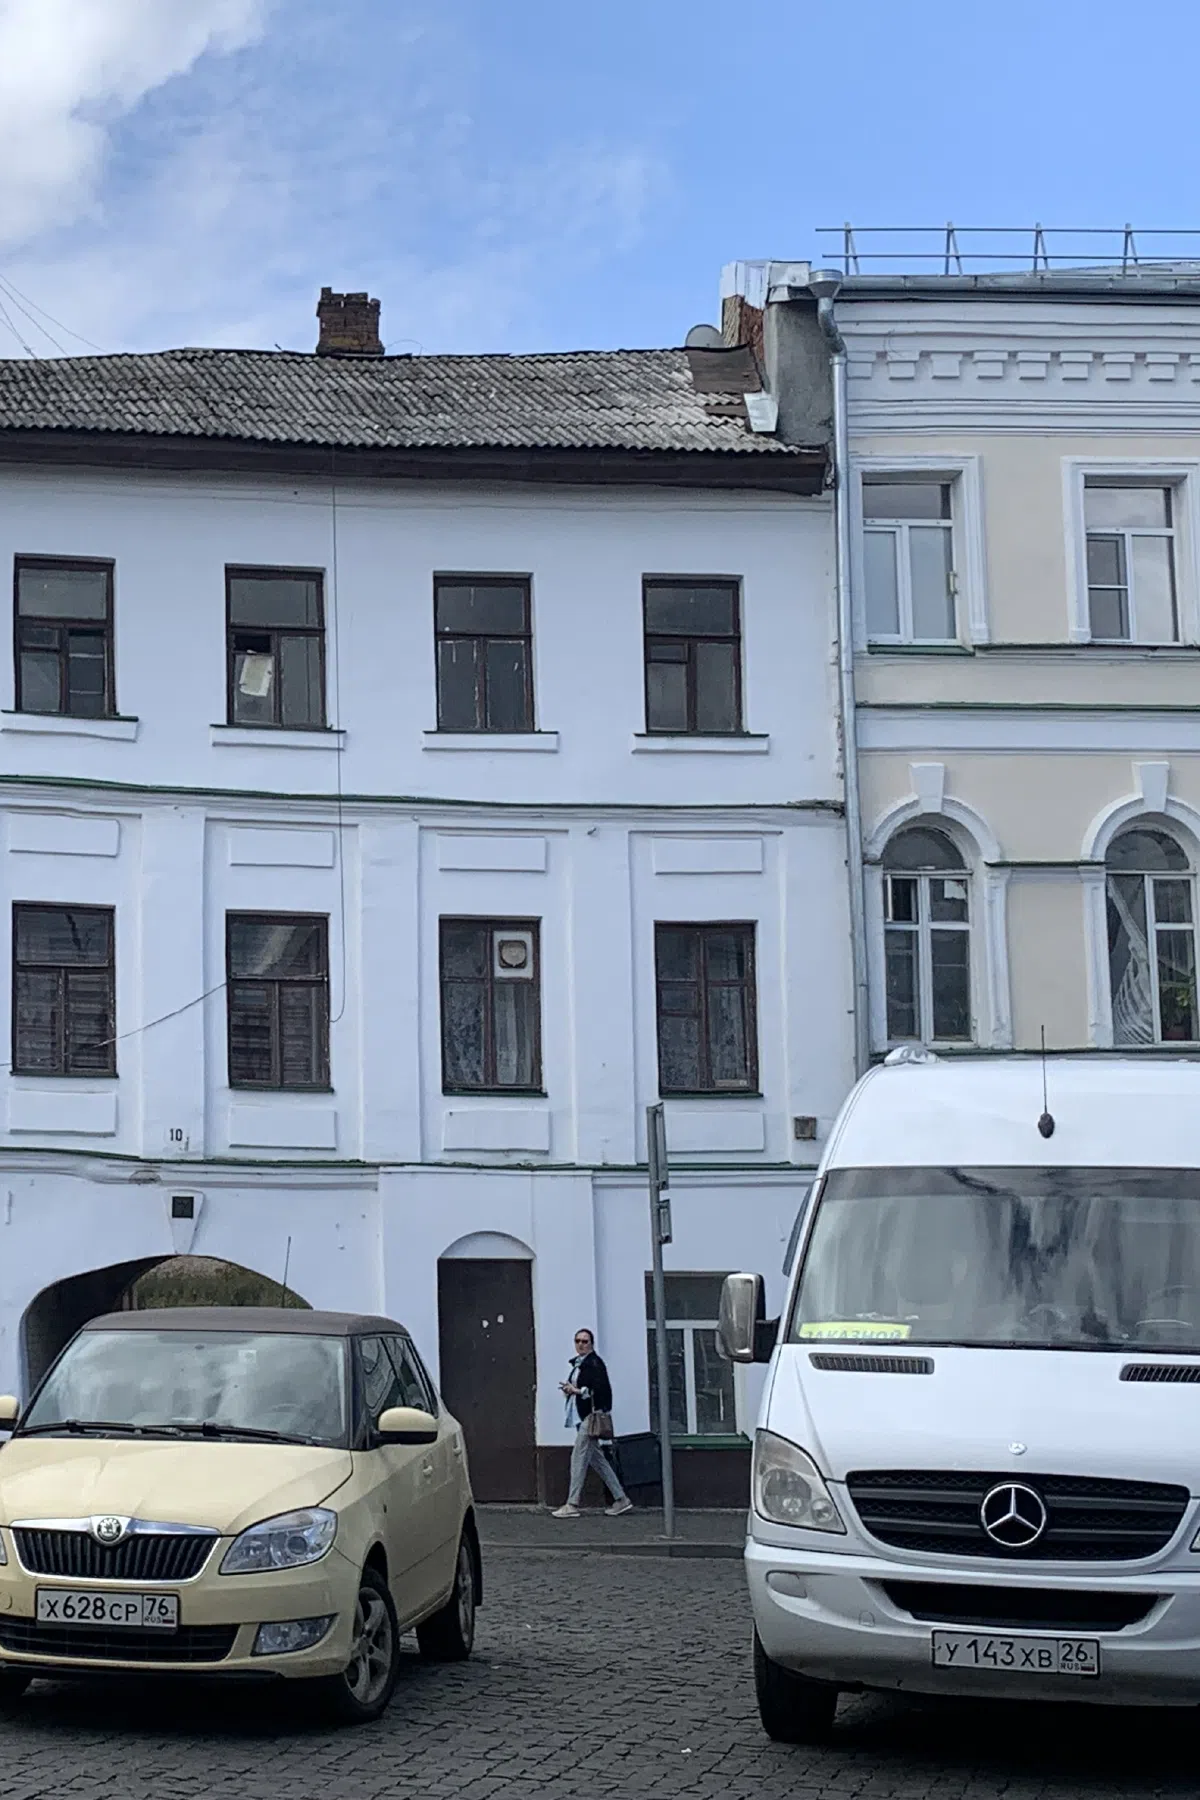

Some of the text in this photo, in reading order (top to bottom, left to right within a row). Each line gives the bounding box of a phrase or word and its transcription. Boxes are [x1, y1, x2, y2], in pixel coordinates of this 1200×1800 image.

[170, 1128, 183, 1141] 10
[145, 1598, 169, 1616] 76
[144, 1616, 162, 1624] RUS
[1061, 1642, 1088, 1662] 26
[1060, 1662, 1081, 1671] RUS
